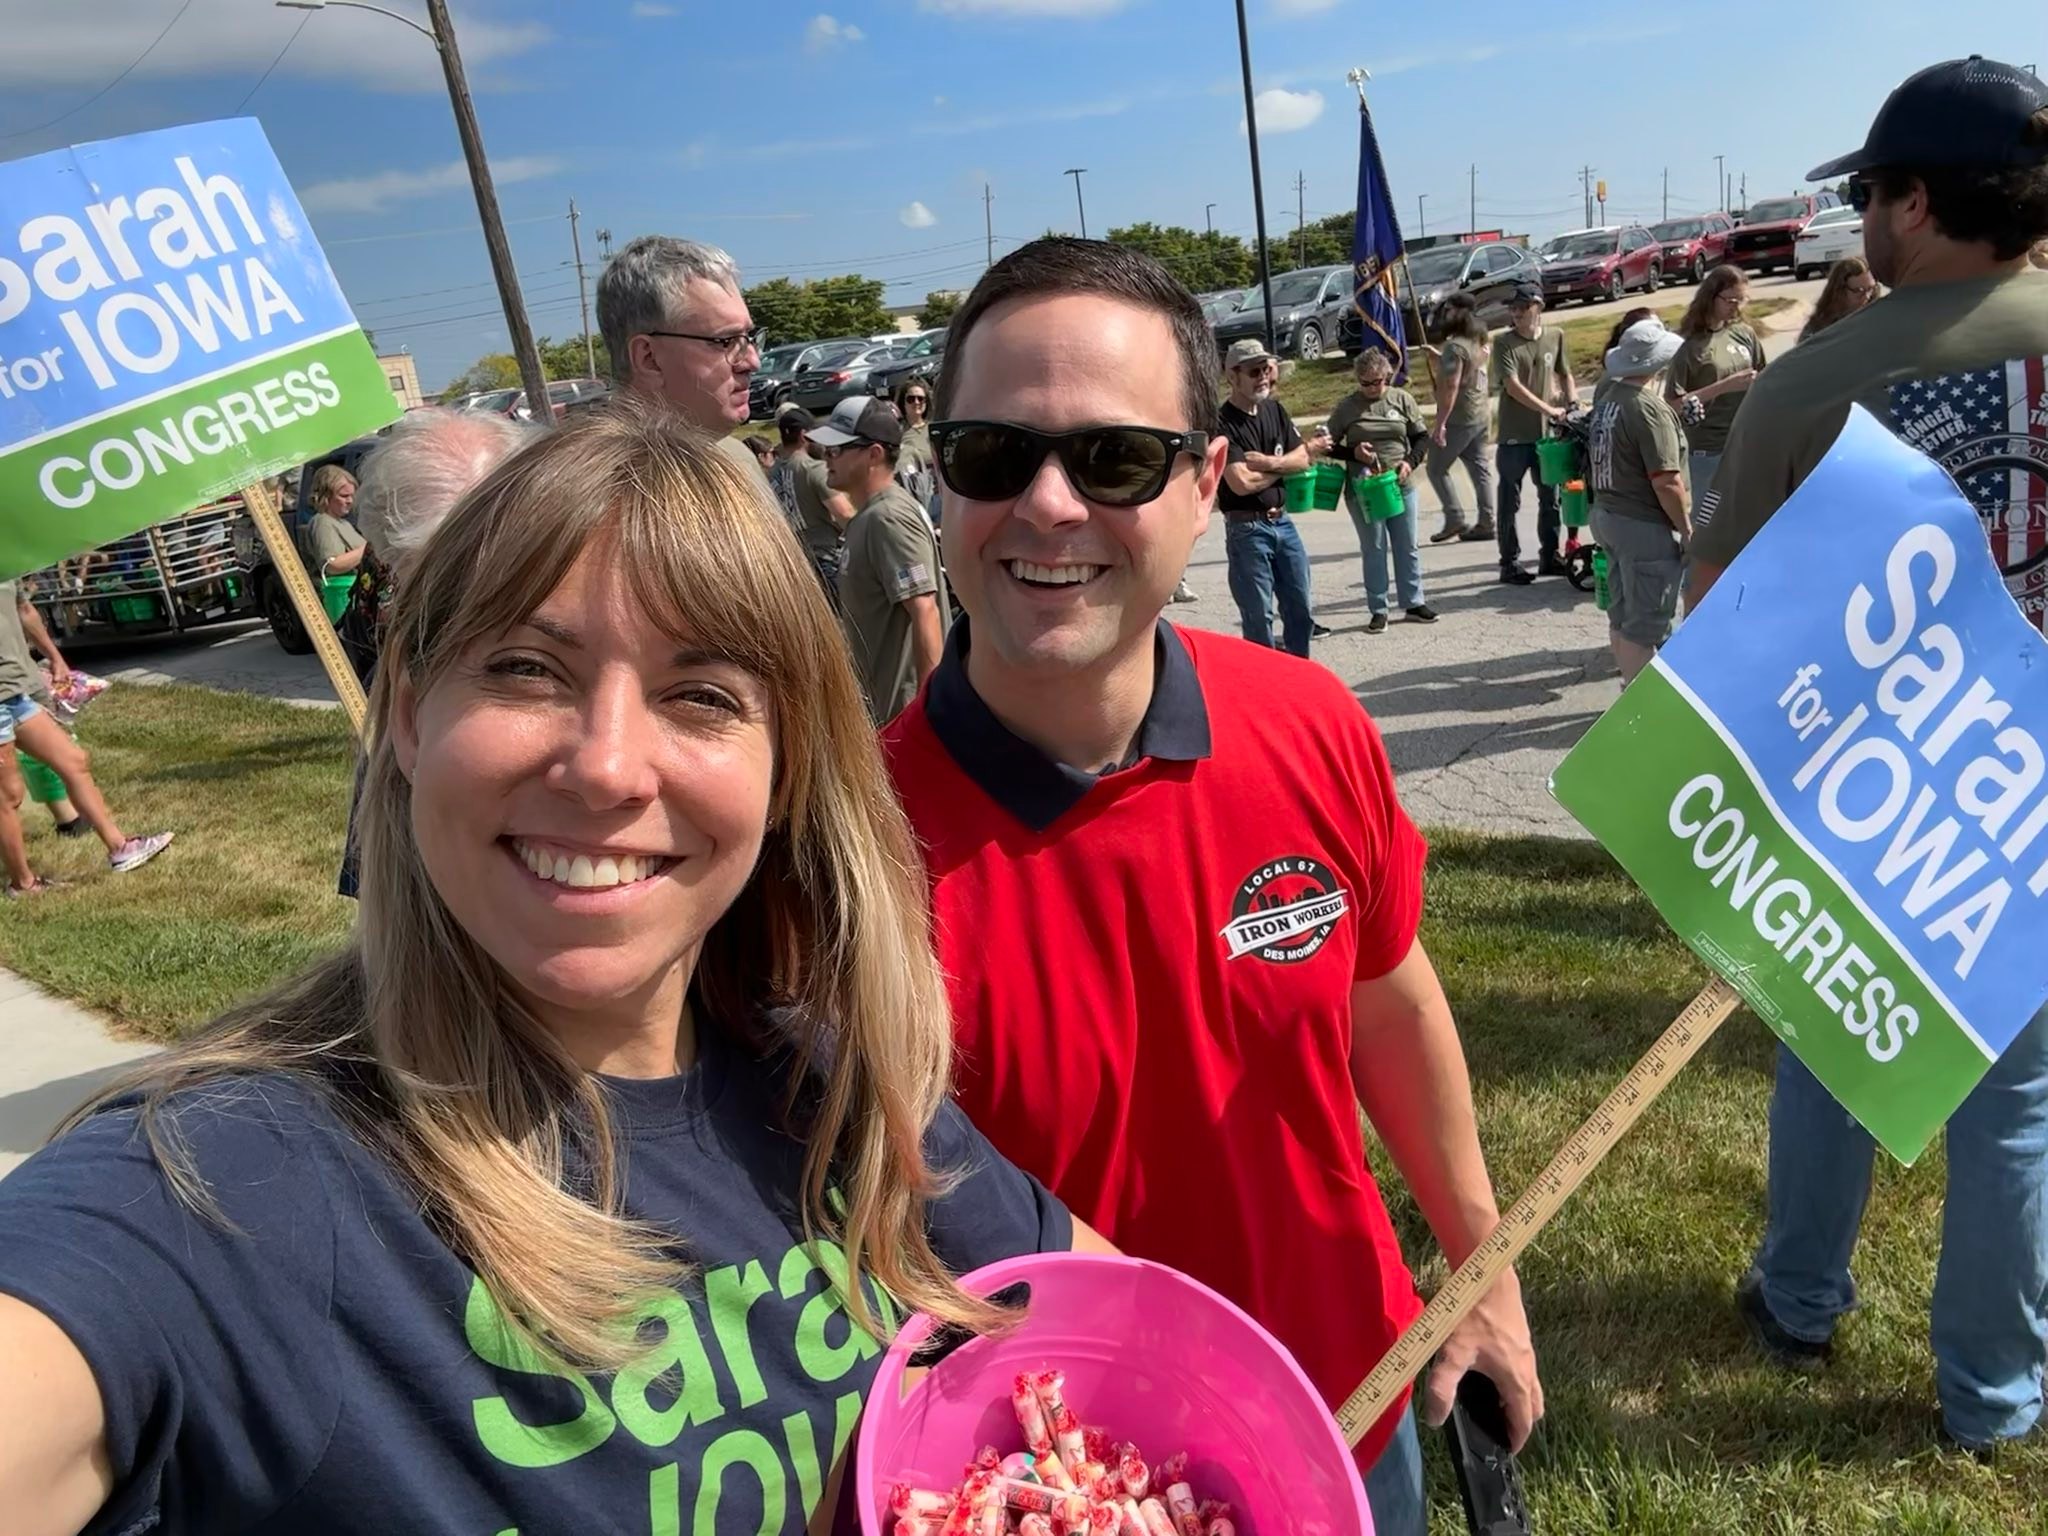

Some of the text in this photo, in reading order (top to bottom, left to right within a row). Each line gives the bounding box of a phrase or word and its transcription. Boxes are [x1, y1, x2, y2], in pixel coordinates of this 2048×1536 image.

[58, 257, 304, 390] IOWA
[39, 362, 340, 509] CONGRESS
[1900, 403, 1955, 443] ONGER
[1916, 418, 1967, 454] ETHER
[1777, 663, 2012, 981] for IOWA
[1244, 861, 1315, 895] LOCAL 67
[1668, 773, 1920, 1064] CONGRESS
[1238, 917, 1292, 944] IRON
[1263, 948, 1285, 960] DES
[1320, 924, 1330, 936] IA
[1368, 1391, 1381, 1404] 14
[1394, 1361, 1407, 1374] 15
[1419, 1331, 1432, 1344] 16
[1446, 1301, 1458, 1314] 17
[1496, 1241, 1510, 1254] 19
[1521, 1210, 1535, 1226] 20
[1548, 1180, 1561, 1195] 21
[1573, 1151, 1587, 1166] 22
[1600, 1121, 1613, 1137] 23
[1624, 1091, 1638, 1107] 24
[1650, 1063, 1664, 1078] 25
[1677, 1032, 1691, 1048] 26
[1703, 1003, 1716, 1019] 27
